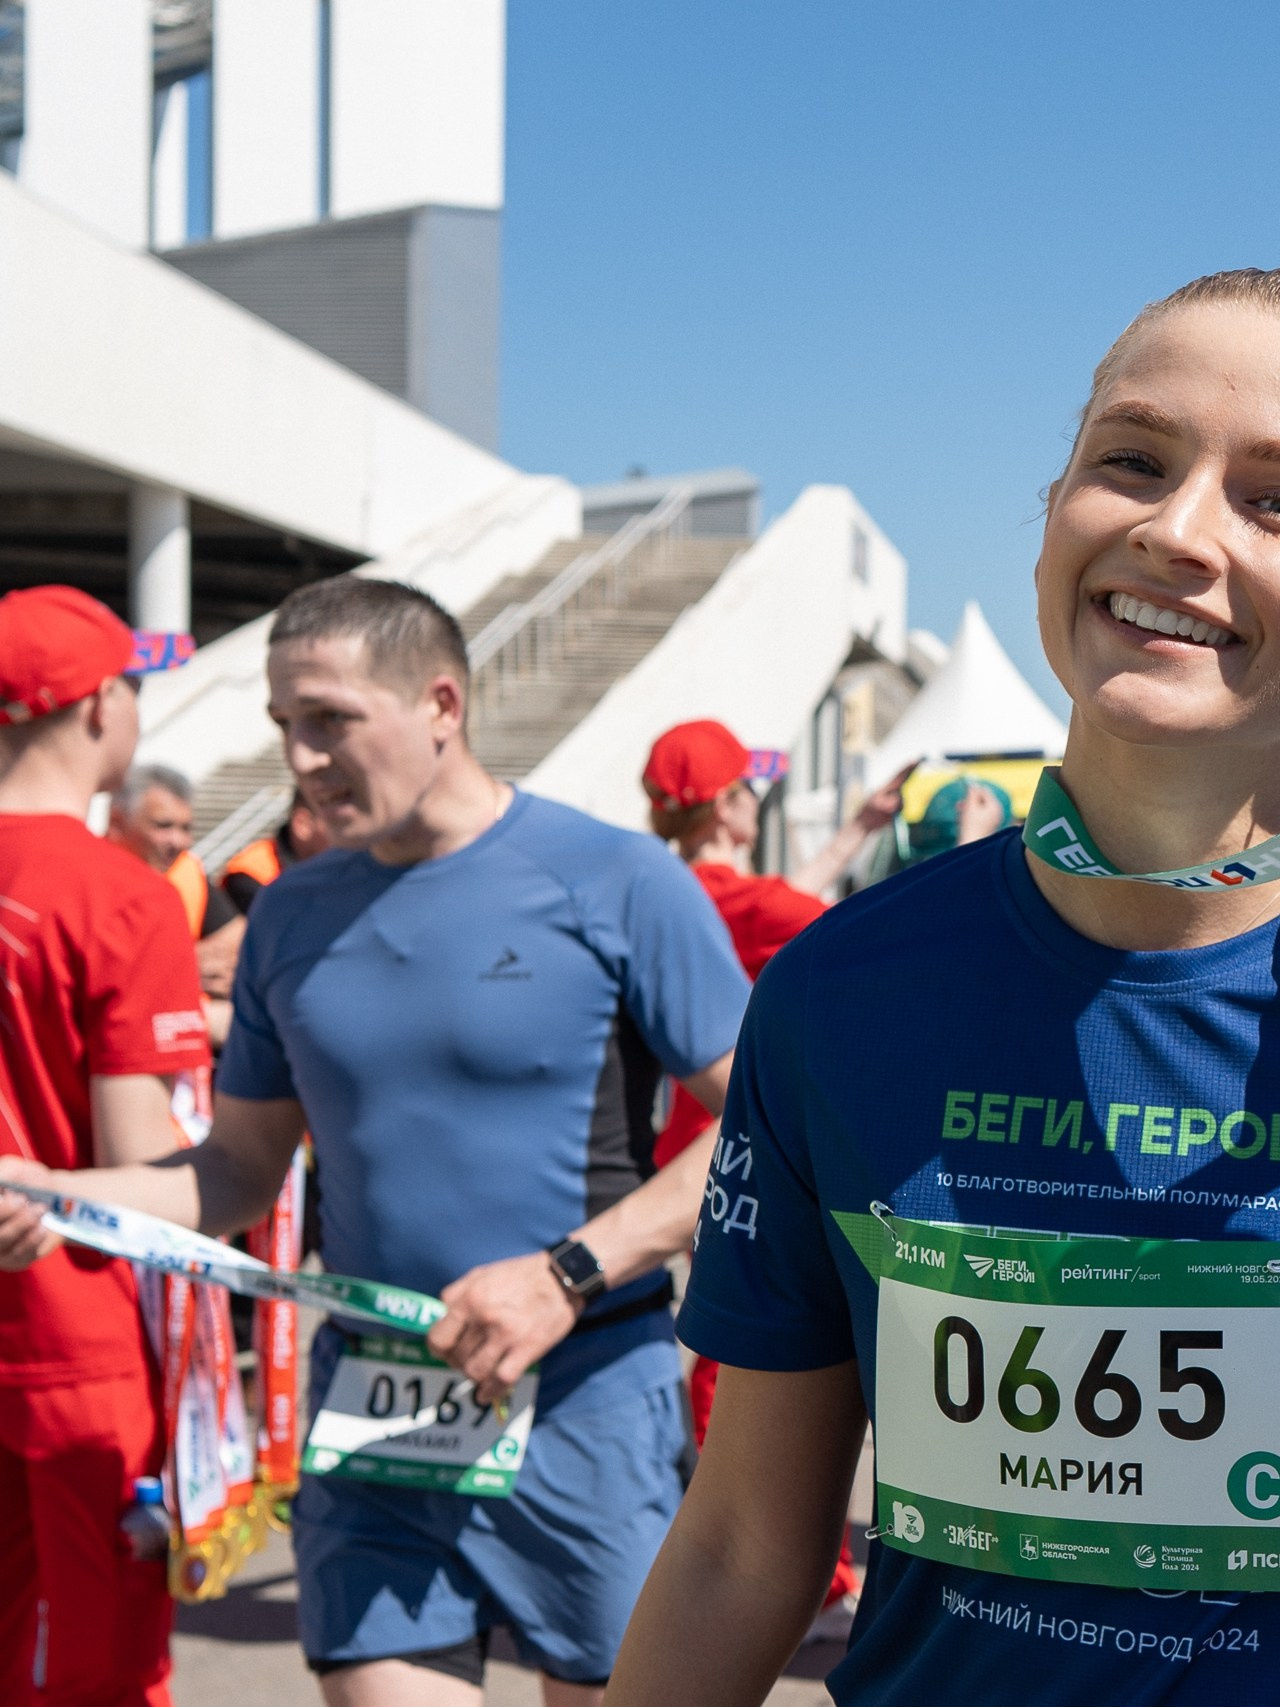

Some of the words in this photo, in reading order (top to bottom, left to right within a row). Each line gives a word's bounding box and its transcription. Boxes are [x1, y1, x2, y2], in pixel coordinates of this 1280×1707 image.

[942, 1090, 1093, 1154] БЕГИ,
[936, 1173, 953, 1187] 10
[957, 1174, 1166, 1201] БЛАГОТВОРИТЕЛЬНЫЙ
[895, 1240, 917, 1263] 21,1
[920, 1247, 945, 1269] КМ
[1187, 1264, 1233, 1274] НИЖНИЙ
[992, 1270, 1035, 1283] ГЕРОЙ!
[933, 1315, 1226, 1441] 0665
[1000, 1452, 1143, 1496] МАРИЯ
[1041, 1542, 1109, 1555] НИЖЕГОРОДСКАЯ
[1161, 1545, 1203, 1555] Культурная
[1042, 1551, 1077, 1561] ОБЛАСТЬ
[1161, 1555, 1193, 1563] Столица
[1161, 1562, 1178, 1571] Года
[1180, 1563, 1200, 1571] 2024
[1037, 1614, 1193, 1662] НОВГОРОД
